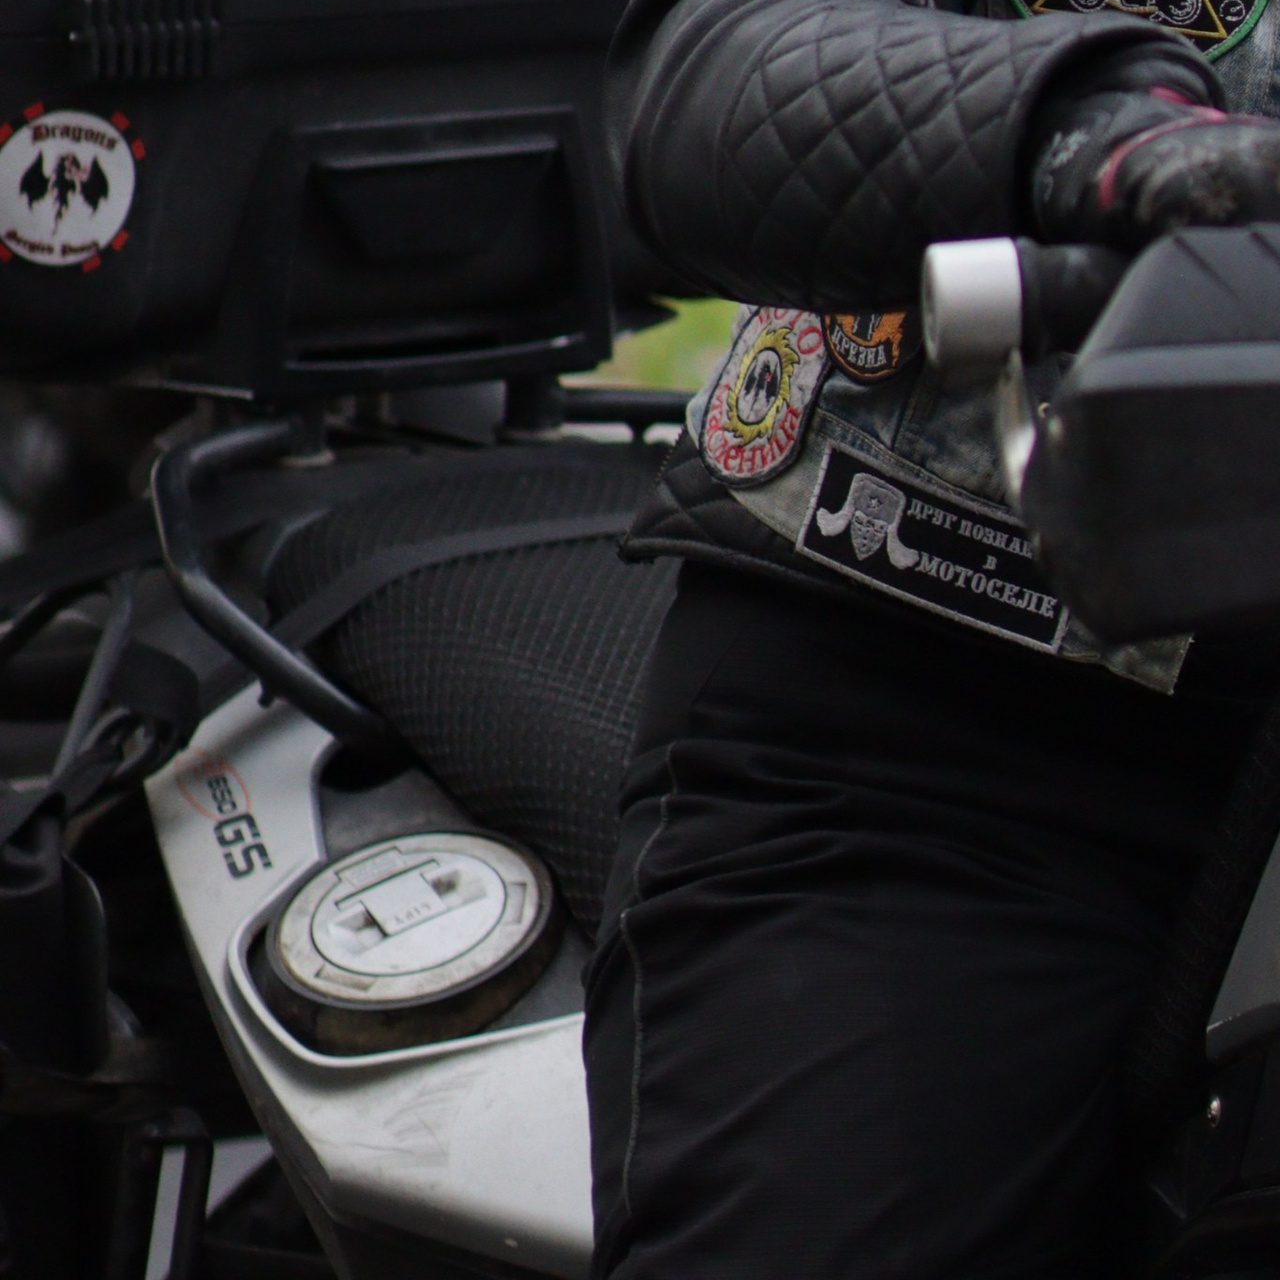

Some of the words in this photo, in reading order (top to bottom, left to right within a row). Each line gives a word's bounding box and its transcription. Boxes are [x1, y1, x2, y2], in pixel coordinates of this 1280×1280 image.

[31, 123, 118, 151] Dragons
[907, 497, 958, 530] ДРУГ
[914, 550, 1059, 619] МОТОСЕЛЕ
[213, 812, 273, 881] GS
